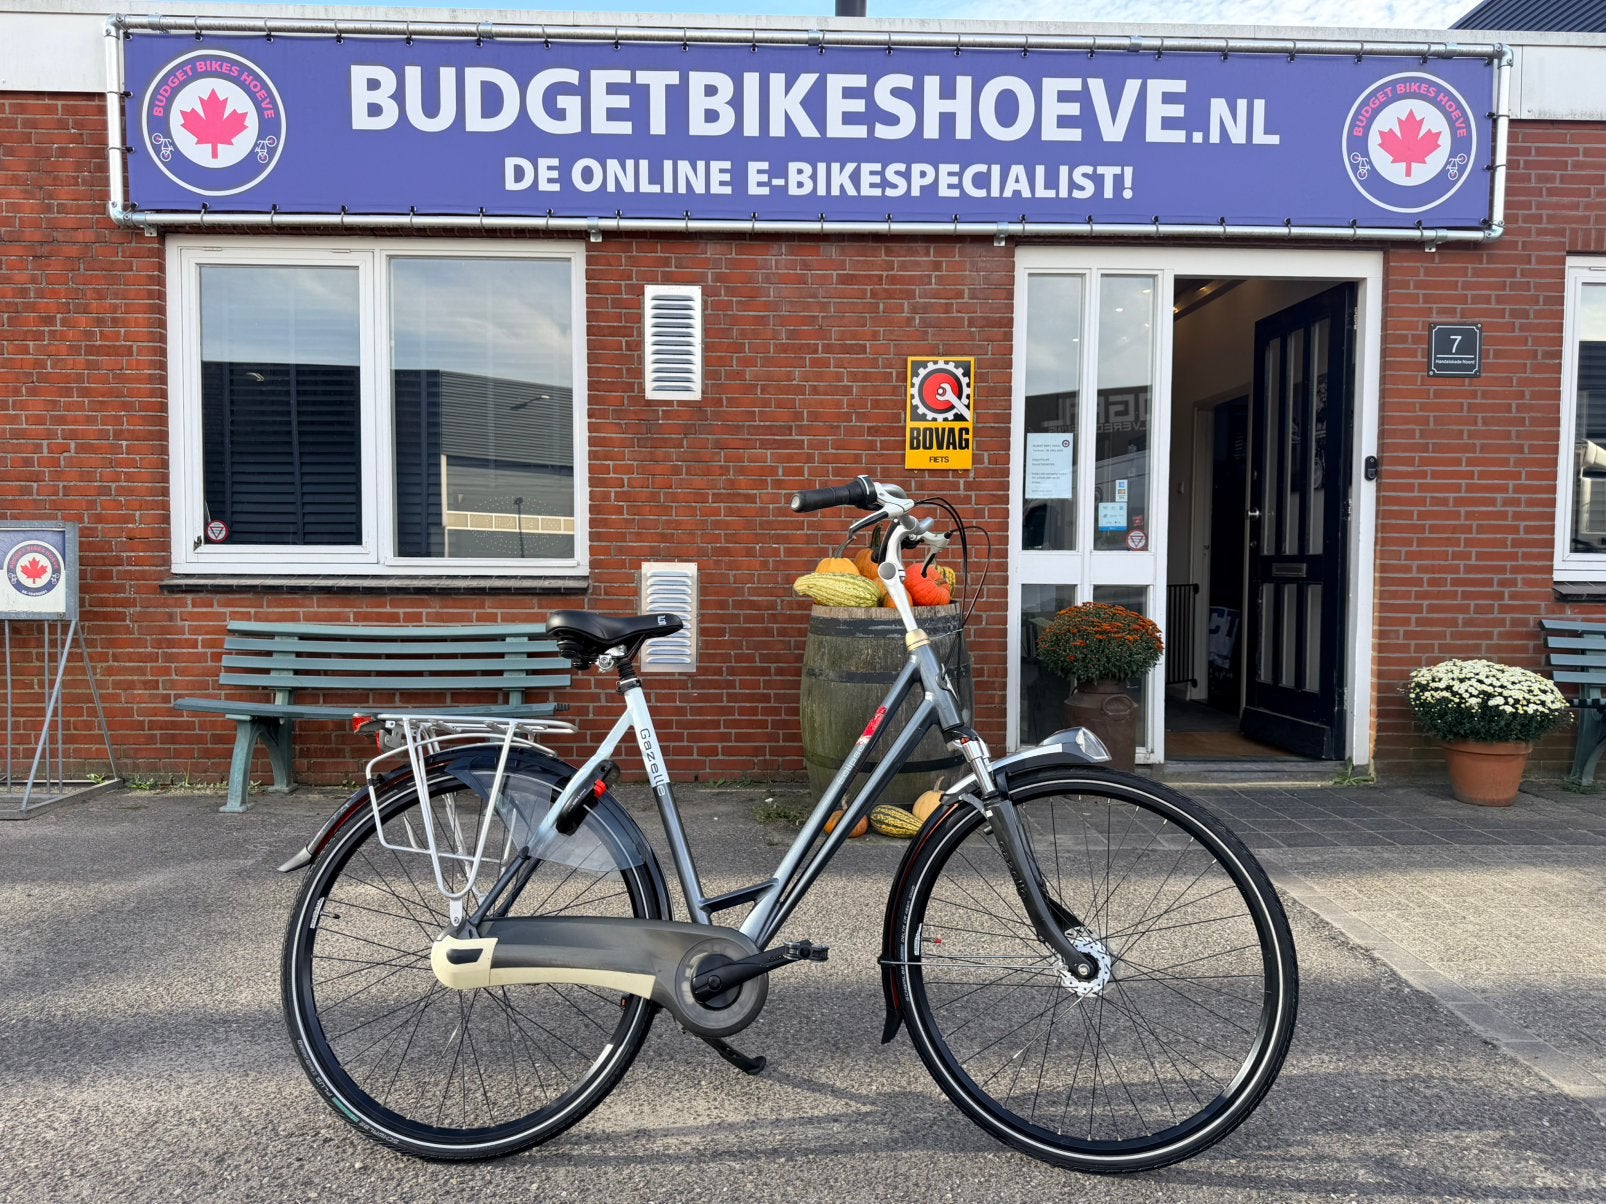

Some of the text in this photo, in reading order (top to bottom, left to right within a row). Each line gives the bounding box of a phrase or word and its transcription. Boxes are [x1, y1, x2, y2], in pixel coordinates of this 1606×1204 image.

[153, 60, 275, 120] BUDGET BIKES HOEVE
[350, 64, 1281, 145] BUDGETBIKESHOEVE.NL
[1353, 82, 1467, 138] BUDGET BIKES HOEVE
[504, 156, 1133, 200] DE ONLINE E-BIKESPECIALIST!
[1450, 335, 1462, 353] 7
[909, 427, 970, 451] BOVAG
[640, 728, 666, 797] Gazelle
